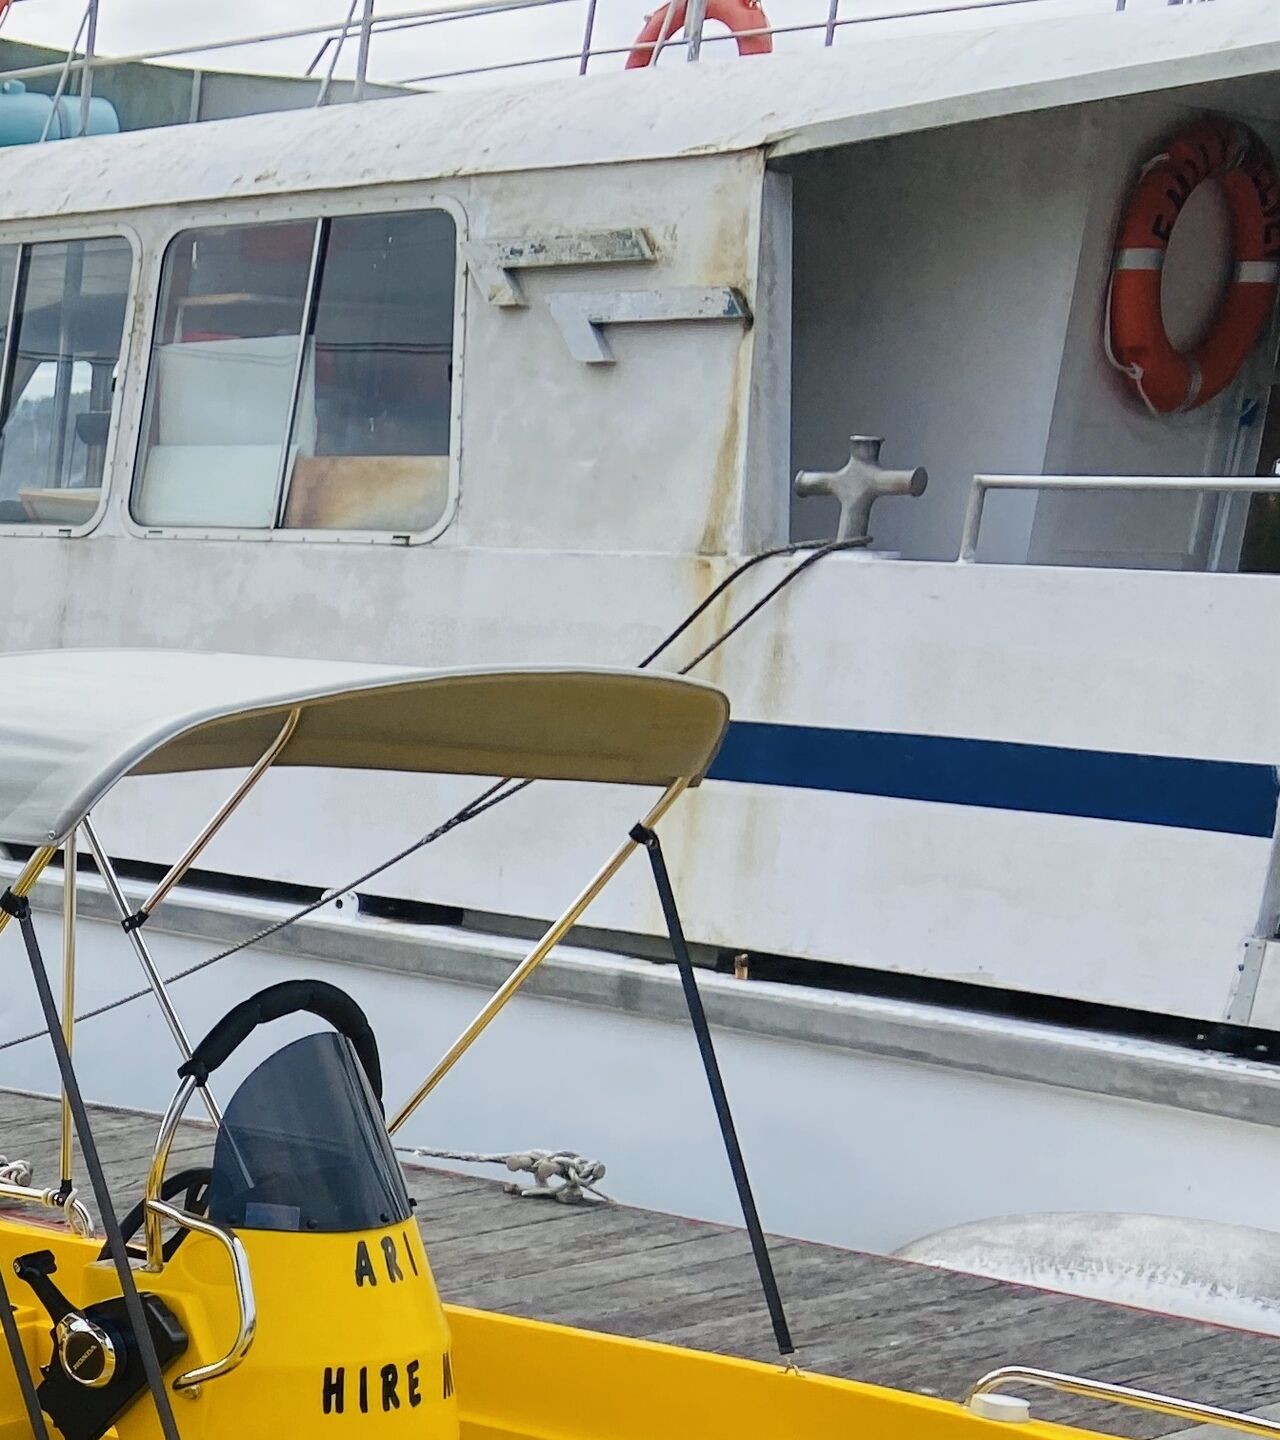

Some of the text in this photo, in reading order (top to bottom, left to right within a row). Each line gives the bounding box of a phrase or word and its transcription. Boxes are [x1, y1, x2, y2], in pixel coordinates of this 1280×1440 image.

[354, 1231, 419, 1288] ARI
[72, 1343, 98, 1371] HONDA
[322, 1359, 422, 1415] HIRE
